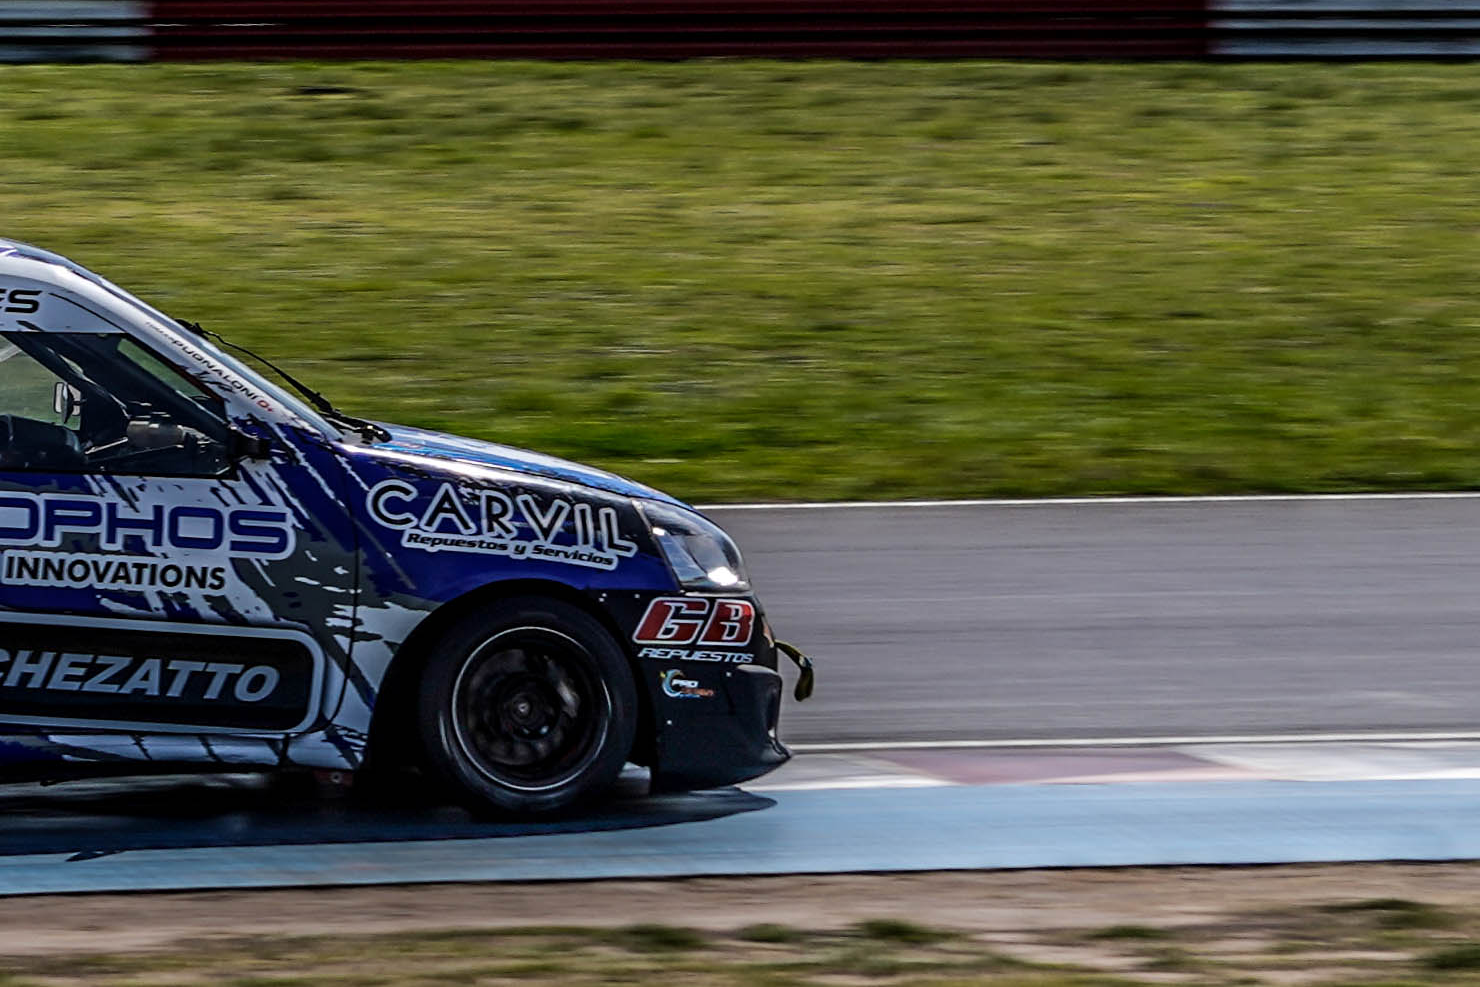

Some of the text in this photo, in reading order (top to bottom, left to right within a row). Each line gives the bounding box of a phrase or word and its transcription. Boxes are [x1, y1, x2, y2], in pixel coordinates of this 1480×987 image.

[370, 483, 634, 555] CARVIL
[406, 532, 615, 567] Repuestos y Servicios
[5, 555, 227, 591] INNOVATIONS
[631, 596, 756, 647] GB
[637, 647, 755, 664] REPUESTOS
